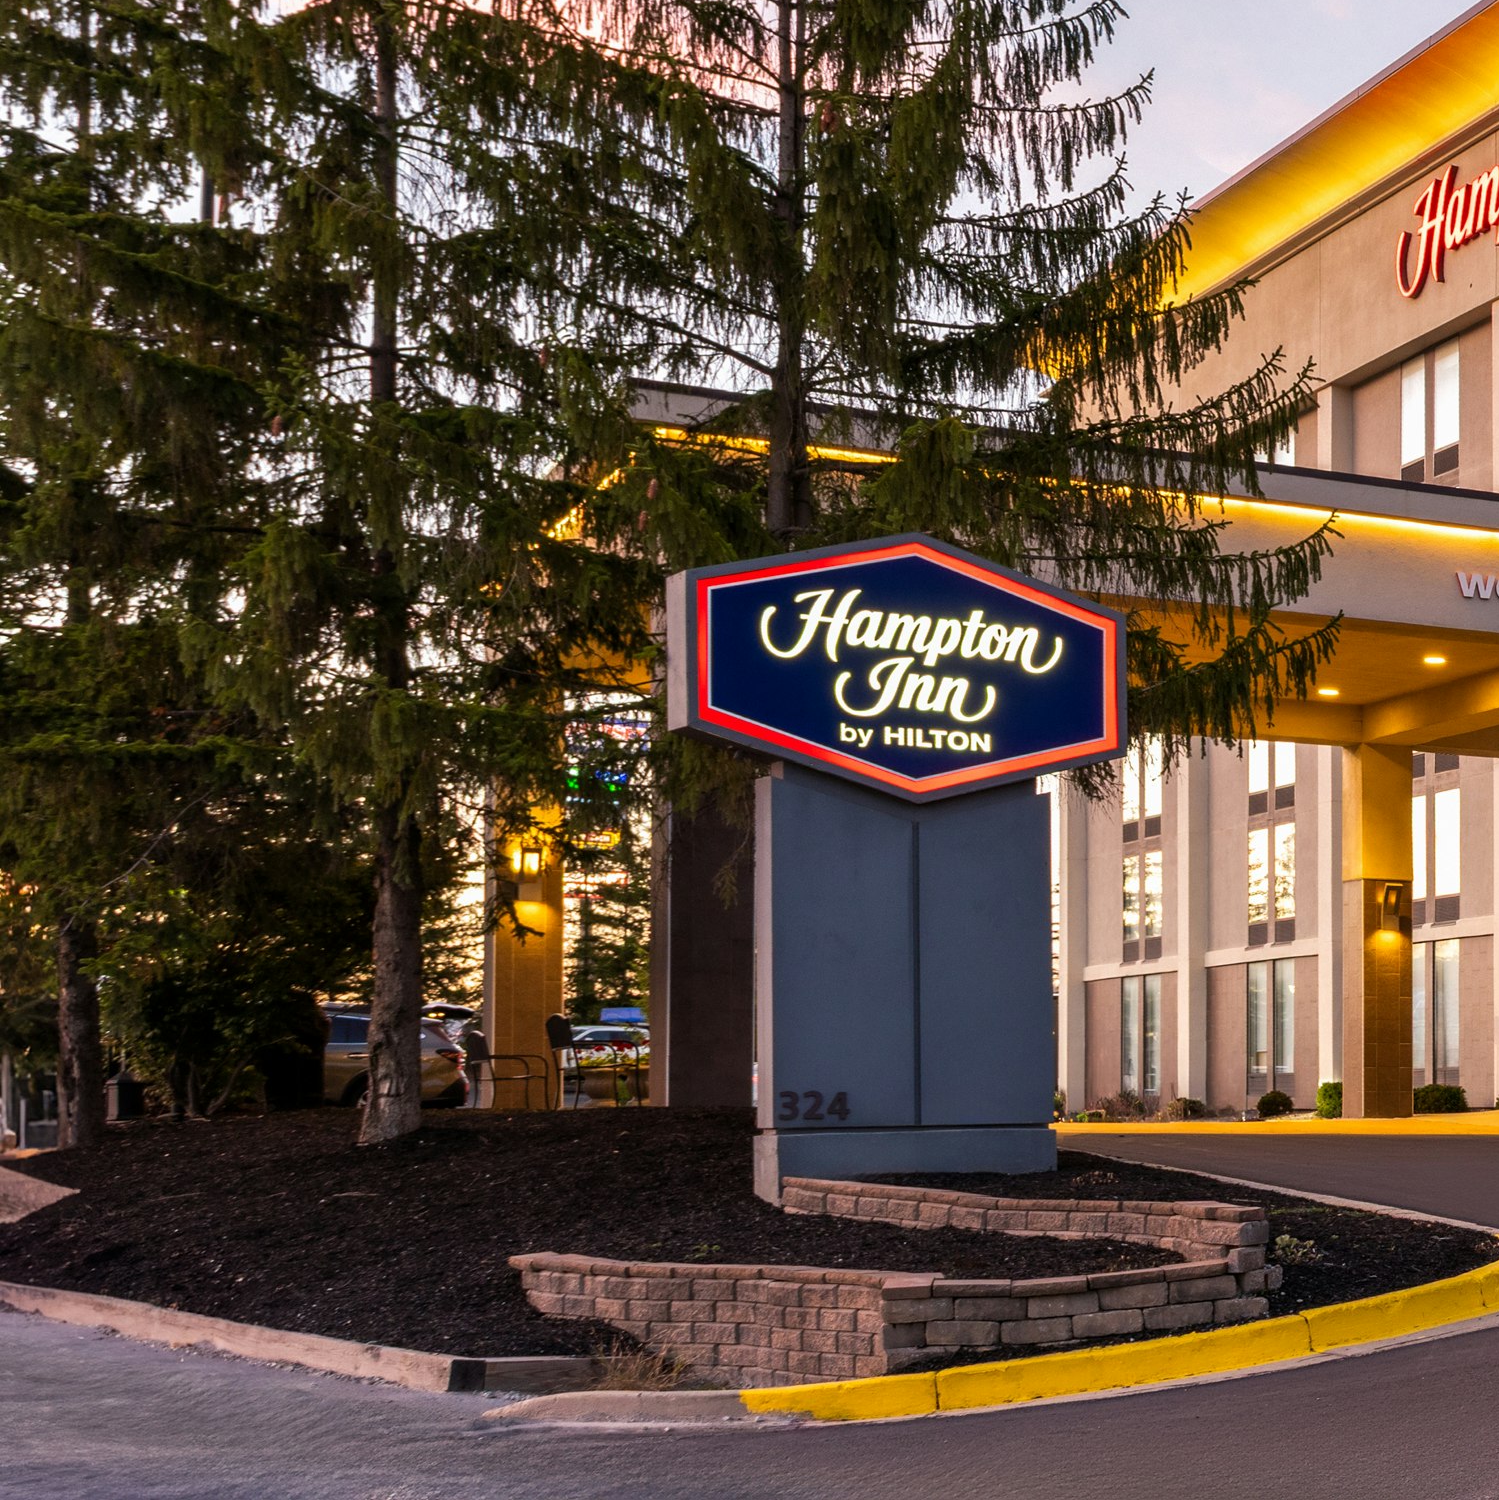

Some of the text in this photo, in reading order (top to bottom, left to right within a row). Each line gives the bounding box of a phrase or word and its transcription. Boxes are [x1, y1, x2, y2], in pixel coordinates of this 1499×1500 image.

[760, 587, 1064, 674] Hampton
[834, 656, 997, 723] Inn
[839, 722, 992, 752] by HILTON
[777, 1089, 851, 1121] 324
